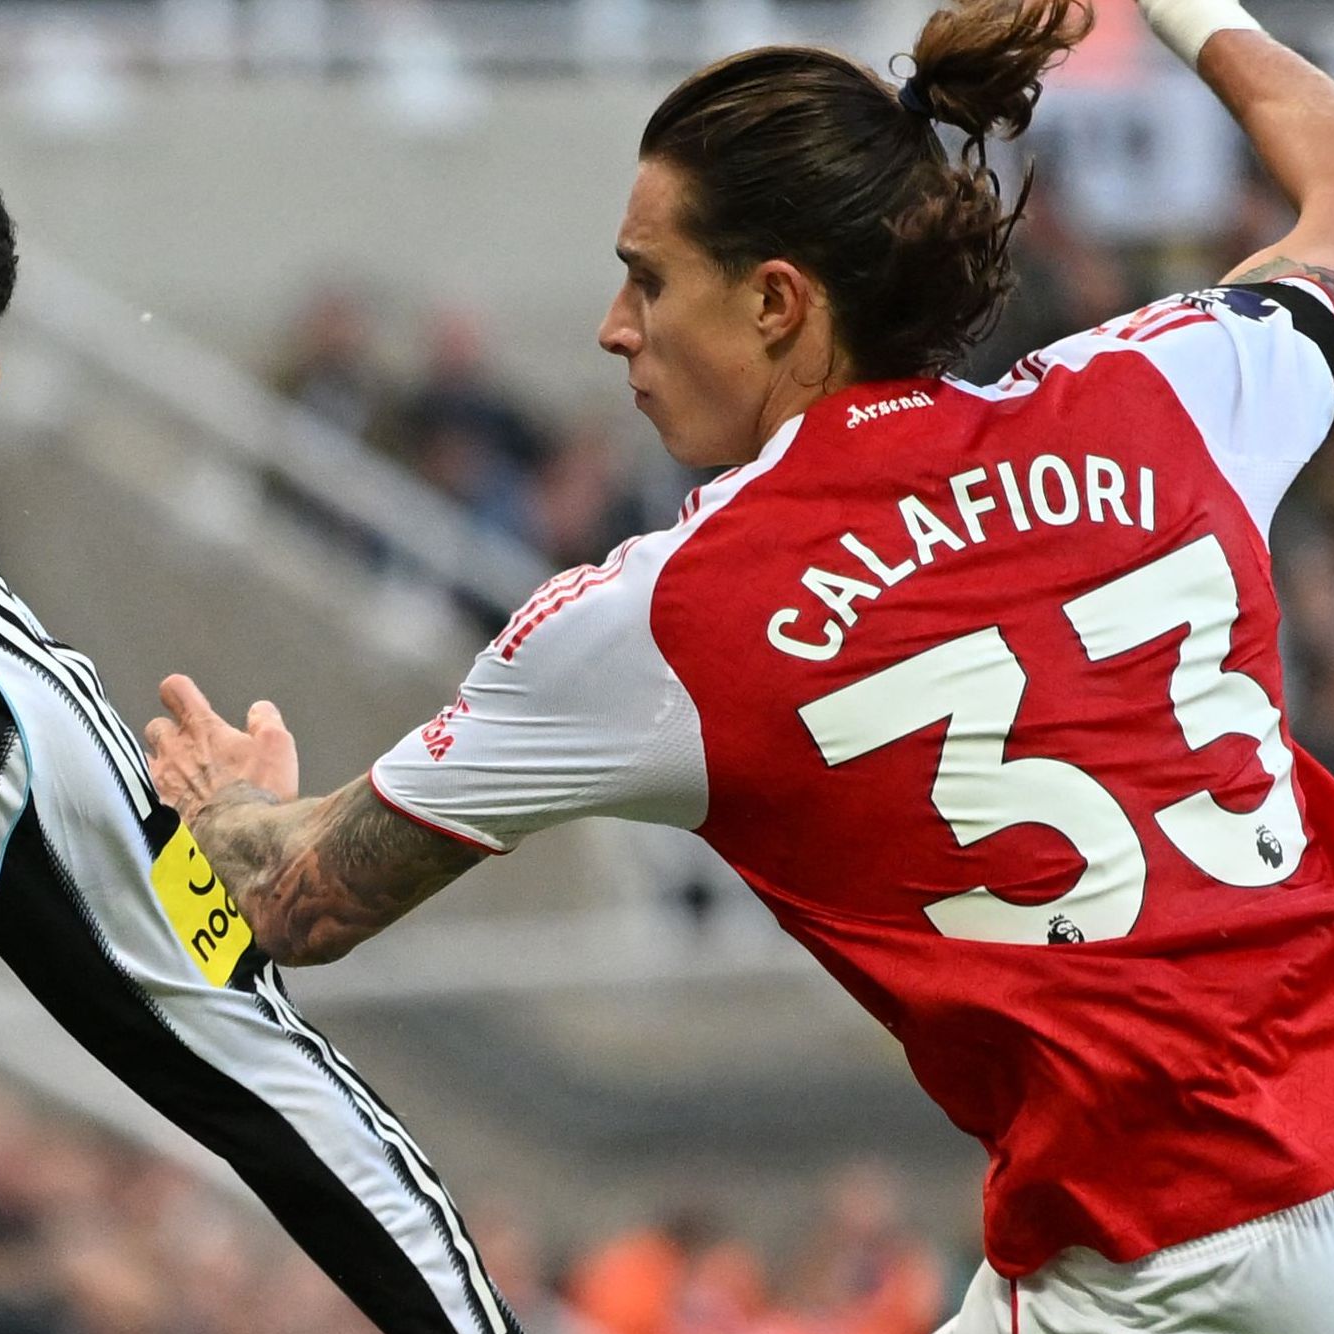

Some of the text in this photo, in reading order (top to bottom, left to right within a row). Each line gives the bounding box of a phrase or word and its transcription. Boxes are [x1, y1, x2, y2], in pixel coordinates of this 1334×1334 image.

[847, 390, 934, 429] Arsenal
[766, 453, 1155, 661] CALAFIORI
[797, 534, 1308, 945] 33
